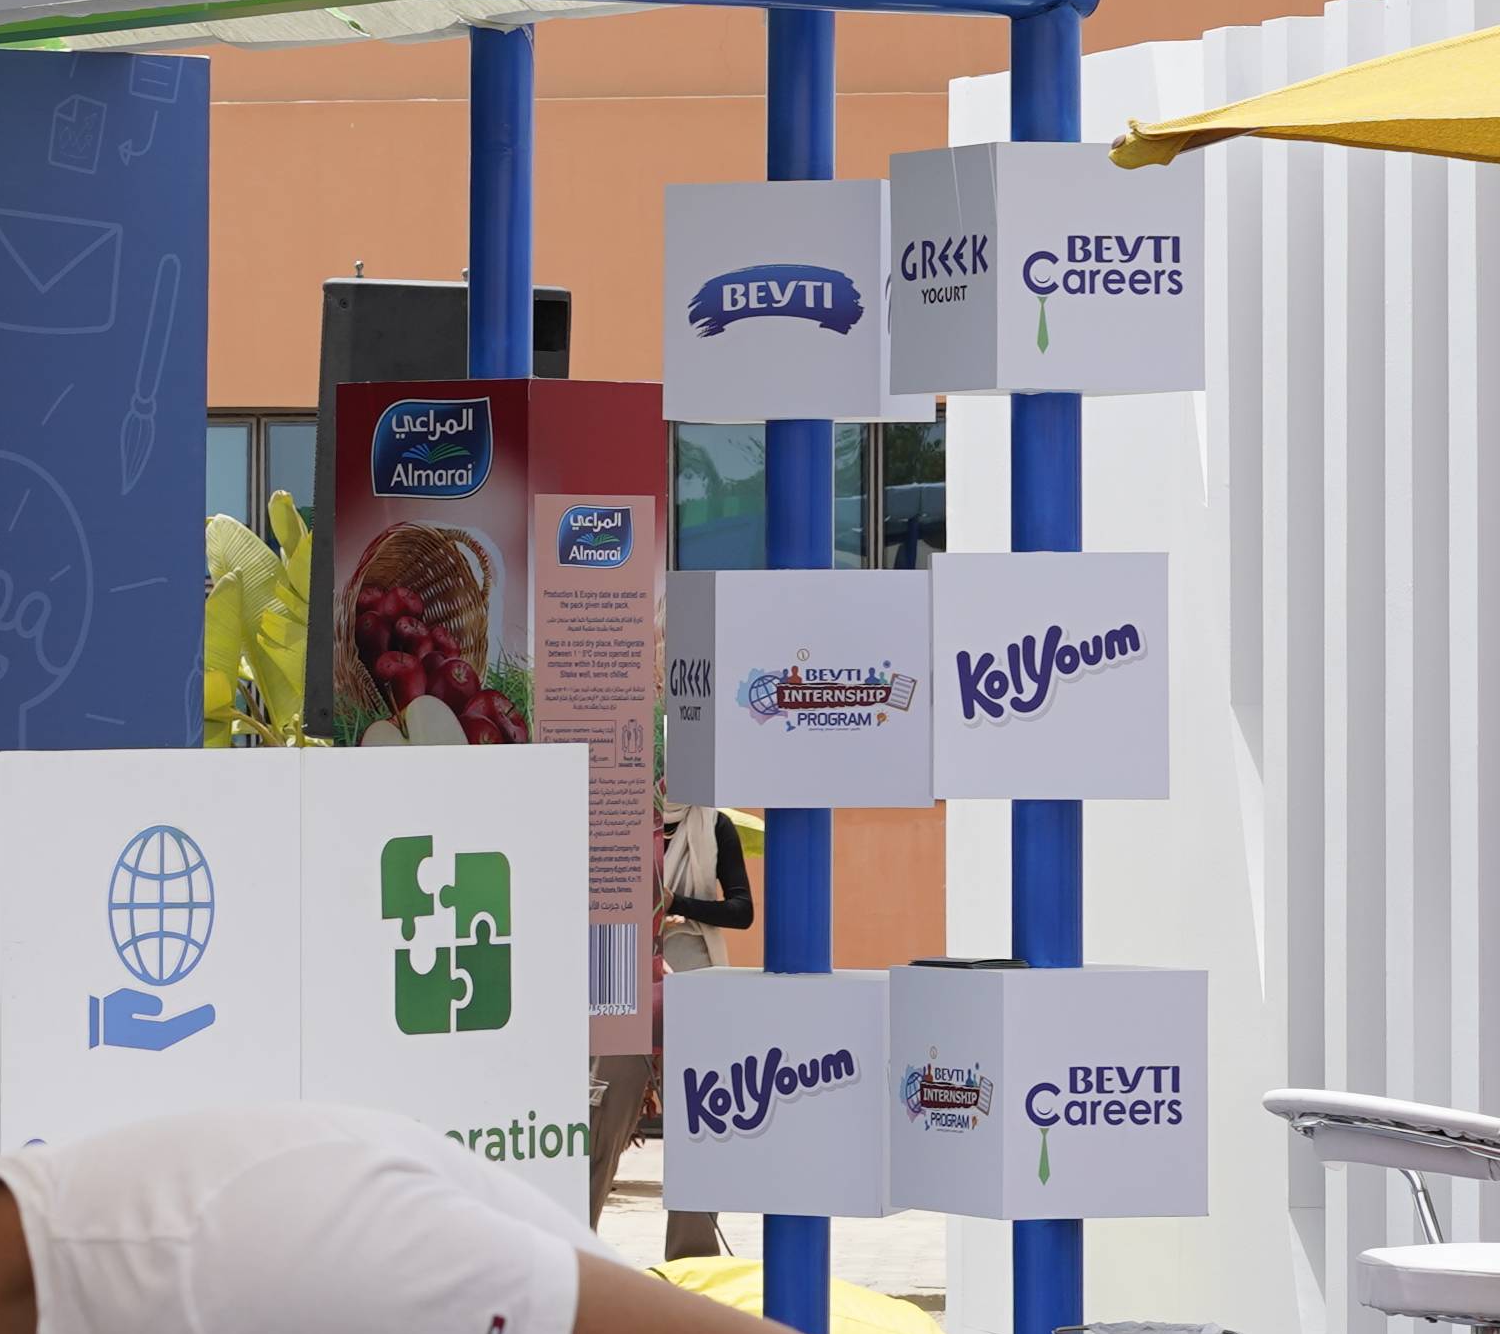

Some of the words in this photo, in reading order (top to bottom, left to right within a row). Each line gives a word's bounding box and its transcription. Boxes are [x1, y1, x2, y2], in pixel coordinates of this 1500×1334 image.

[901, 234, 989, 283] GREEK
[1066, 235, 1181, 263] BEYTI
[1022, 250, 1184, 296] Careers
[722, 280, 833, 312] BEYTI
[921, 284, 967, 305] YOGURT
[391, 406, 474, 439] المراعي
[390, 463, 473, 488] Almarai
[569, 510, 622, 530] المراعي
[568, 544, 622, 562] Almarai
[670, 658, 711, 698] GREEK
[805, 668, 861, 682] BEYTI
[956, 623, 1142, 719] KolYoum
[783, 688, 887, 703] INTERNSHIP
[797, 712, 872, 727] PROGRAM
[683, 1047, 856, 1136] KolYoum
[1068, 1065, 1182, 1094] BEYTI
[923, 1087, 978, 1104] INTERNSHIP
[1025, 1081, 1183, 1128] Careers
[930, 1111, 970, 1129] PROGRAM
